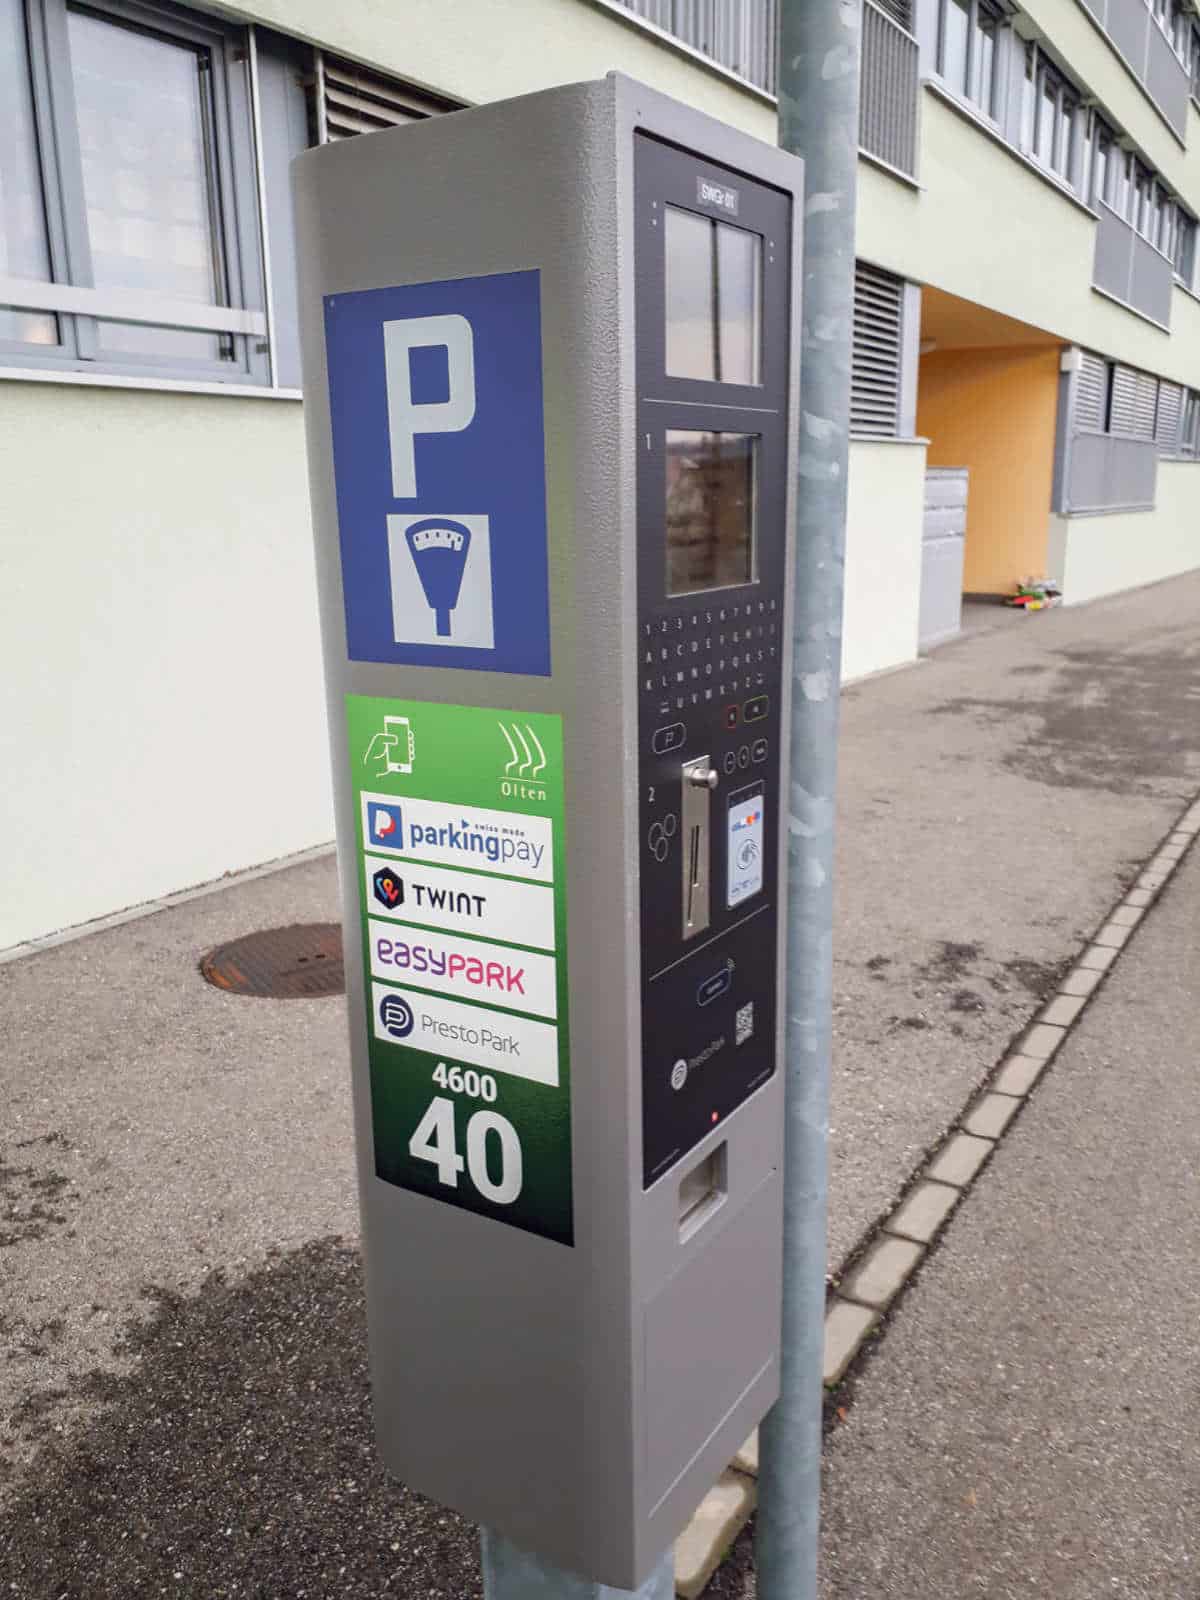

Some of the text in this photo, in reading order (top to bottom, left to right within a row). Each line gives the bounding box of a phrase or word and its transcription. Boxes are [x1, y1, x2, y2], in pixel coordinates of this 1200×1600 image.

[383, 314, 476, 498] P
[501, 782, 547, 801] Olten
[410, 821, 545, 868] parkingpay
[412, 884, 486, 917] TWINT
[432, 1062, 497, 1102] 4600
[408, 1095, 523, 1205] 40
